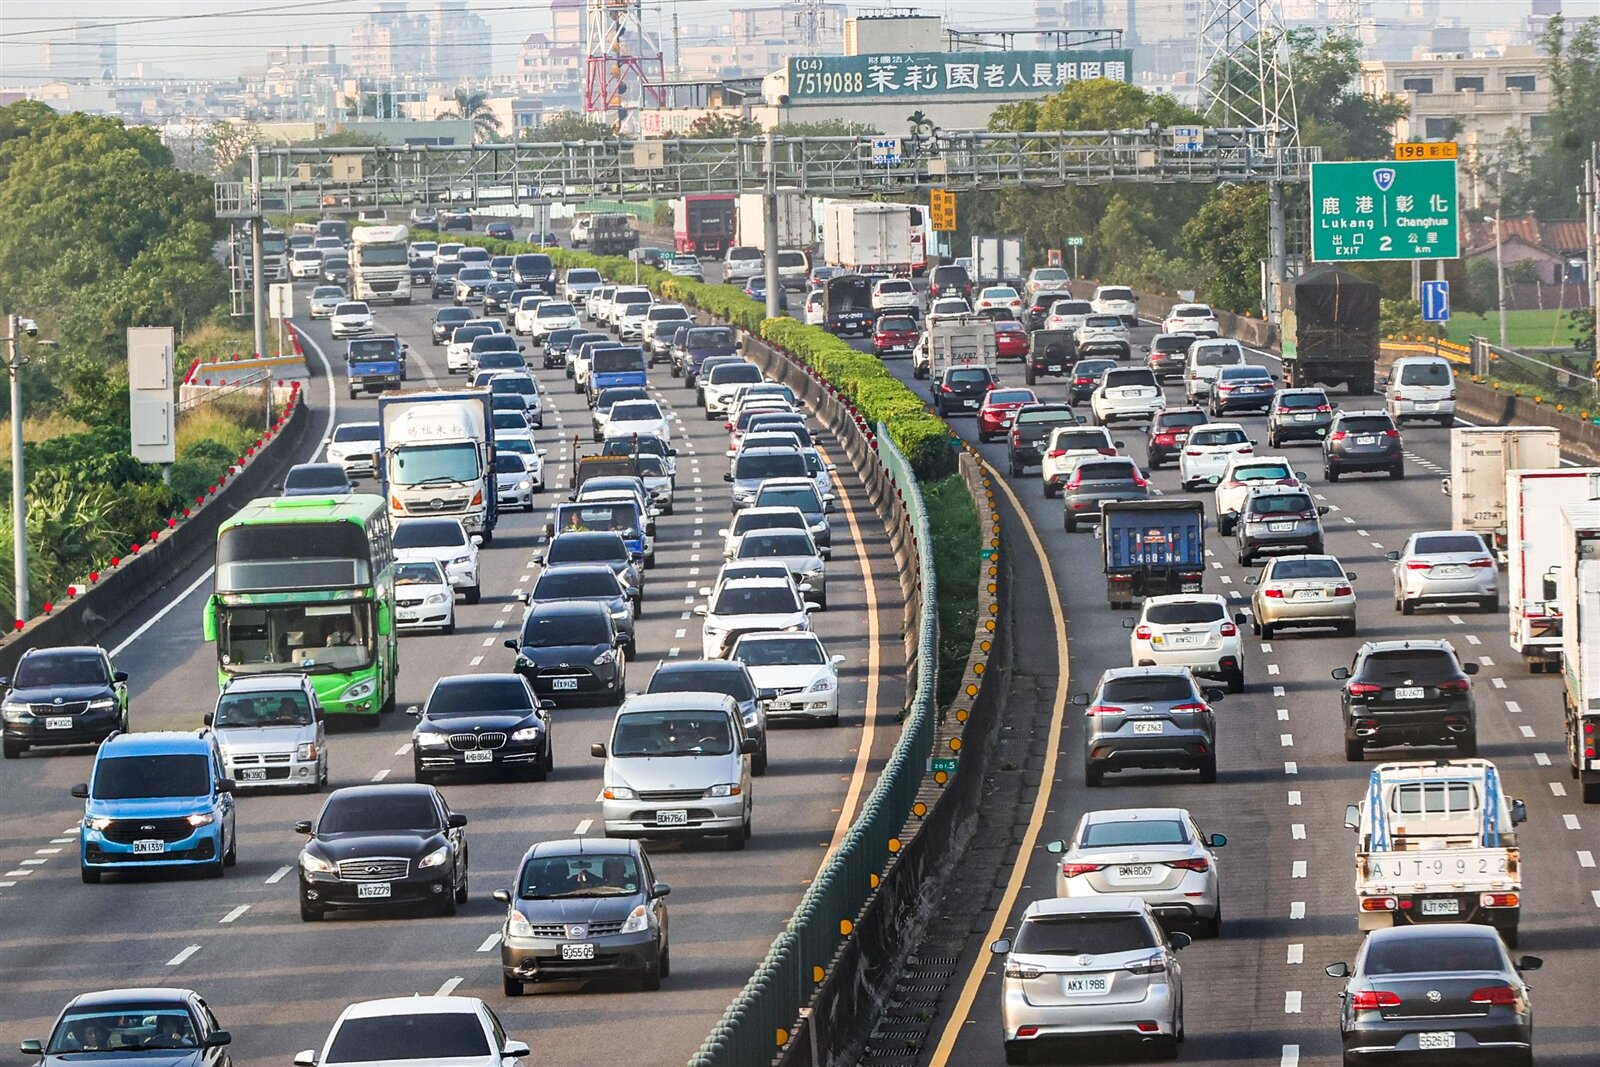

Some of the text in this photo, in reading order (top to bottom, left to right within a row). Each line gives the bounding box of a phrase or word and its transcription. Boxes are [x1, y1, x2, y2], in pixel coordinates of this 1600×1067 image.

[795, 59, 823, 72] (04)
[796, 72, 863, 94] 7519088
[1399, 146, 1453, 158] 198 彰化
[1378, 172, 1391, 183] 19
[1321, 195, 1374, 215] 鹿港
[1395, 194, 1448, 213] 彰化
[1321, 218, 1374, 230] Lukang
[1396, 216, 1449, 229] Changhua
[1067, 237, 1082, 245] 201
[1332, 233, 1364, 245] 出口
[1379, 235, 1393, 251] 2
[1407, 232, 1439, 244] 公里
[1335, 246, 1360, 255] EXIT
[1414, 245, 1432, 254] km
[934, 761, 955, 769] 201.5
[1372, 858, 1506, 877] AJT-9922
